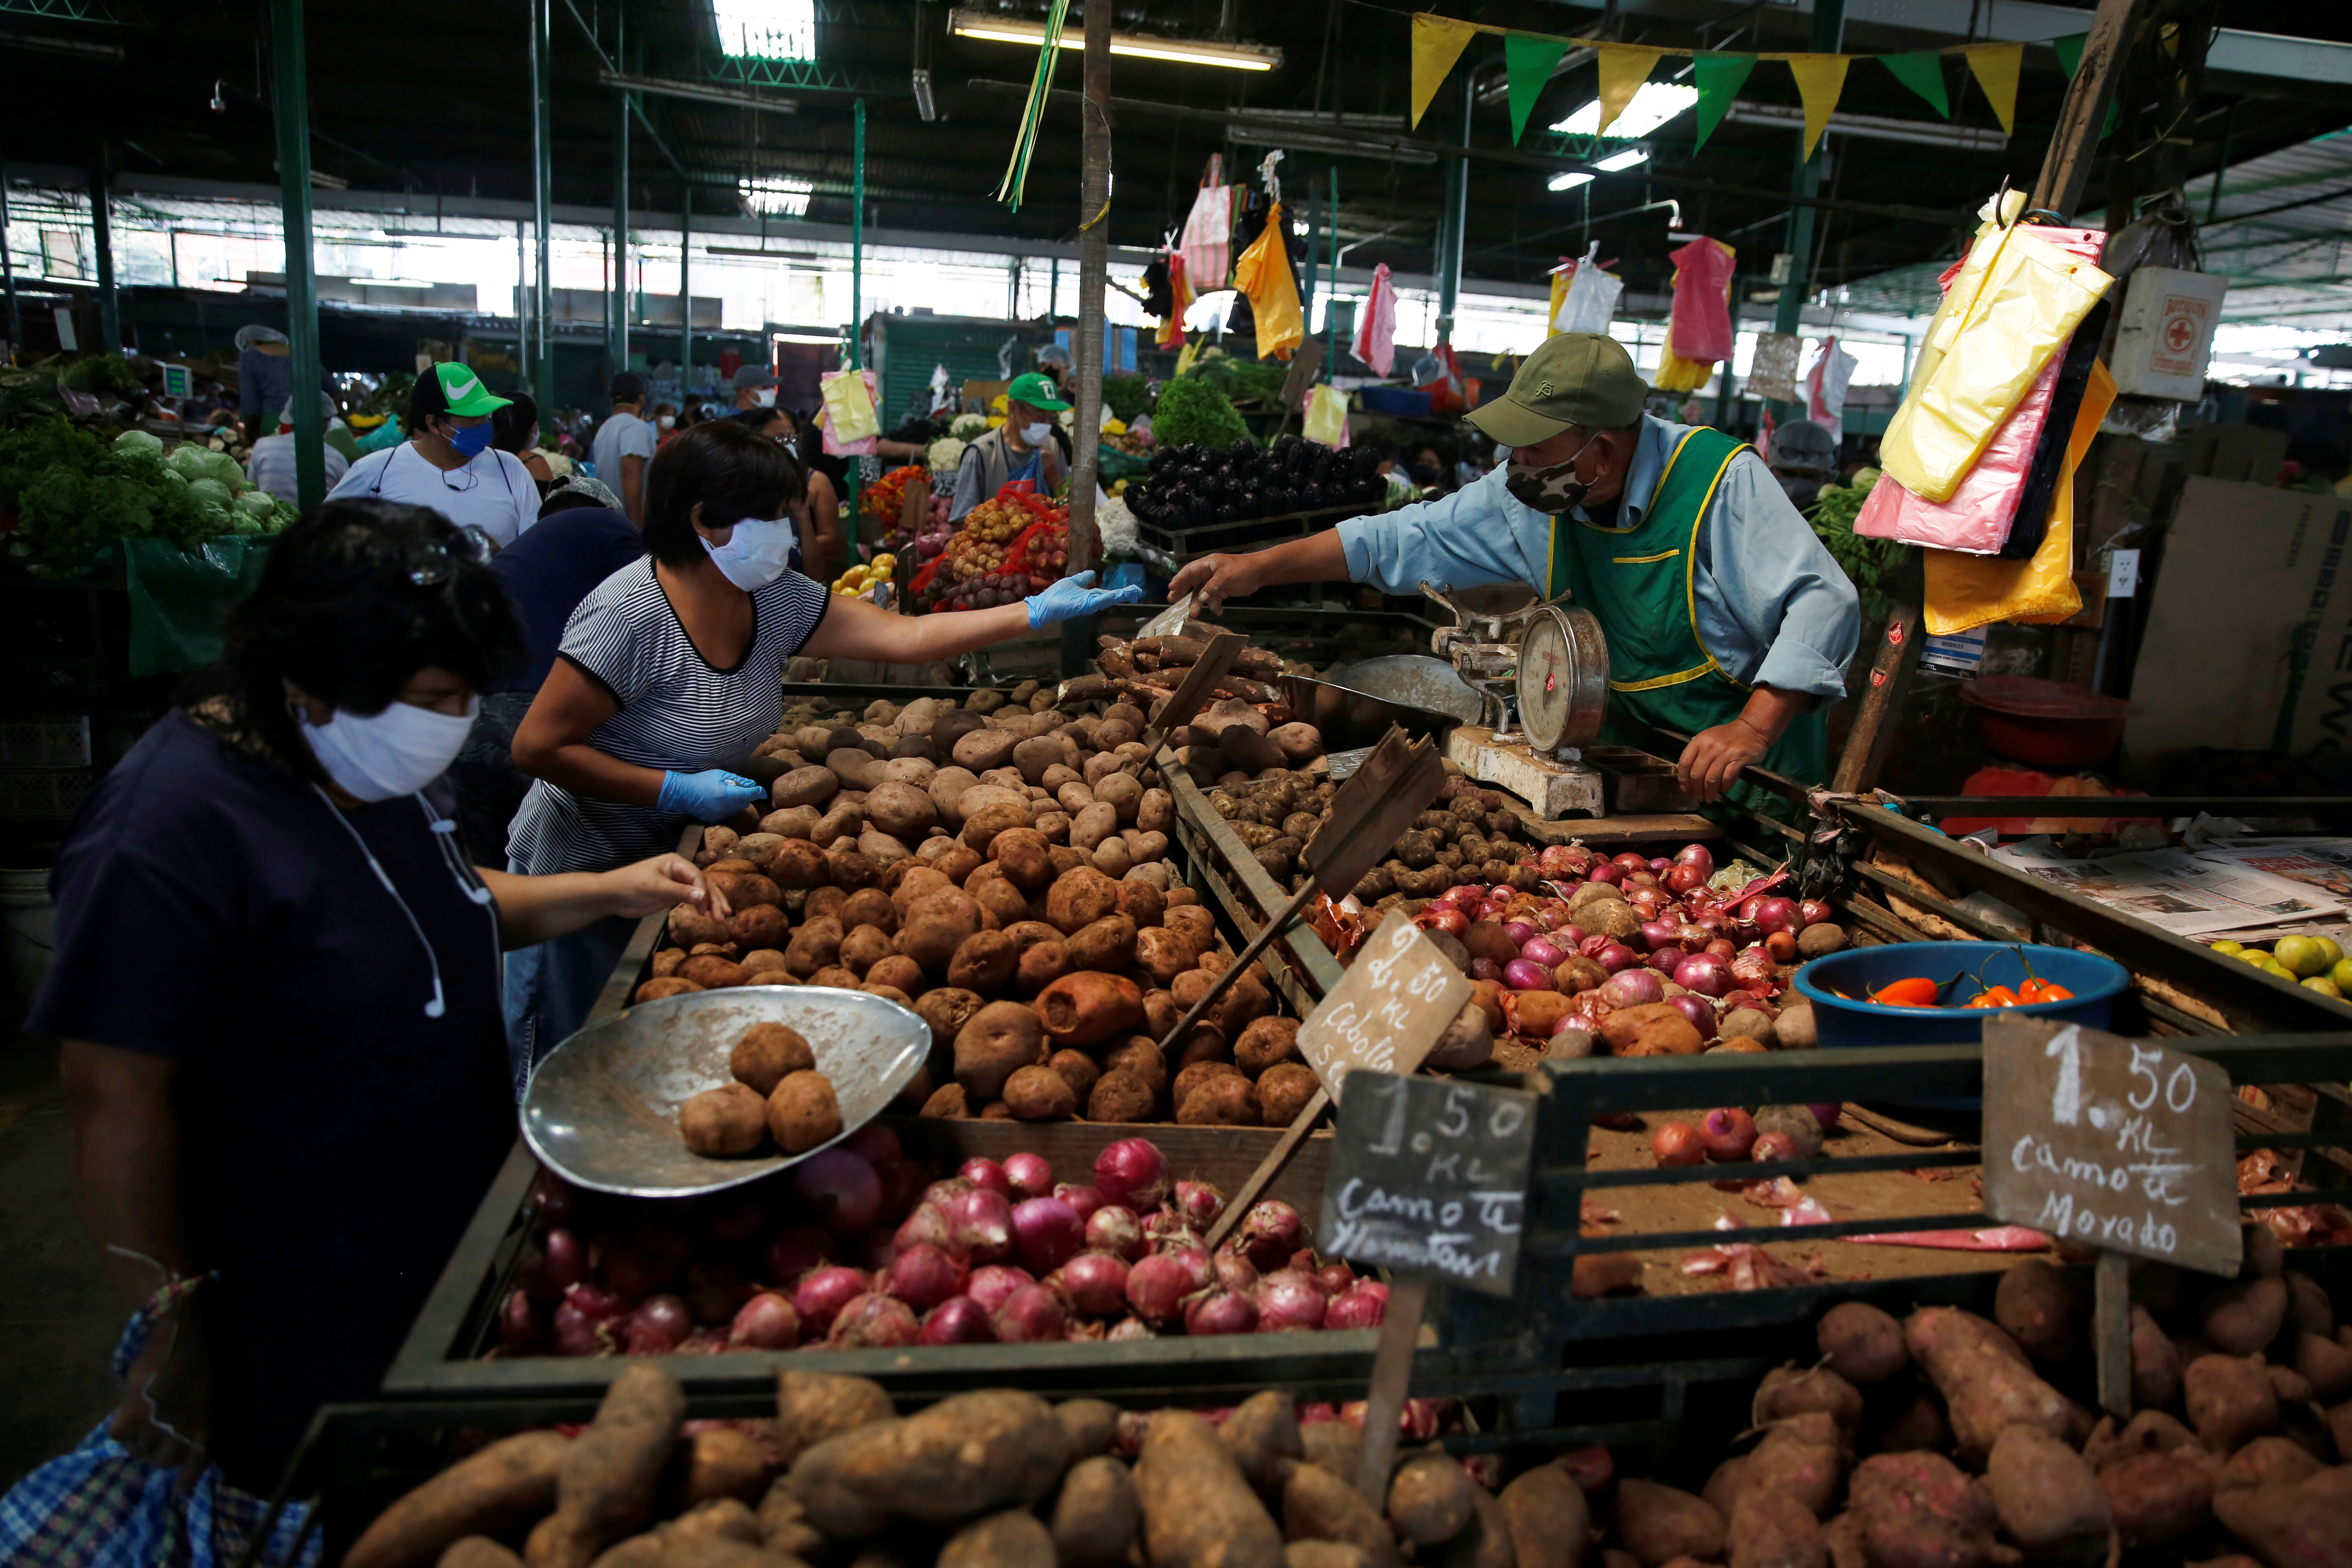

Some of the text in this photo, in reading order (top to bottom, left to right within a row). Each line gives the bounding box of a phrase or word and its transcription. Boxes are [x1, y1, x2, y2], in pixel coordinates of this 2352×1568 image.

[2285, 503, 2312, 568] FREEZER
[1941, 641, 1964, 649] 09269155
[2044, 1024, 2197, 1127] 1.50
[1367, 1076, 1525, 1156] 1.50
[2037, 1190, 2177, 1254] Morado
